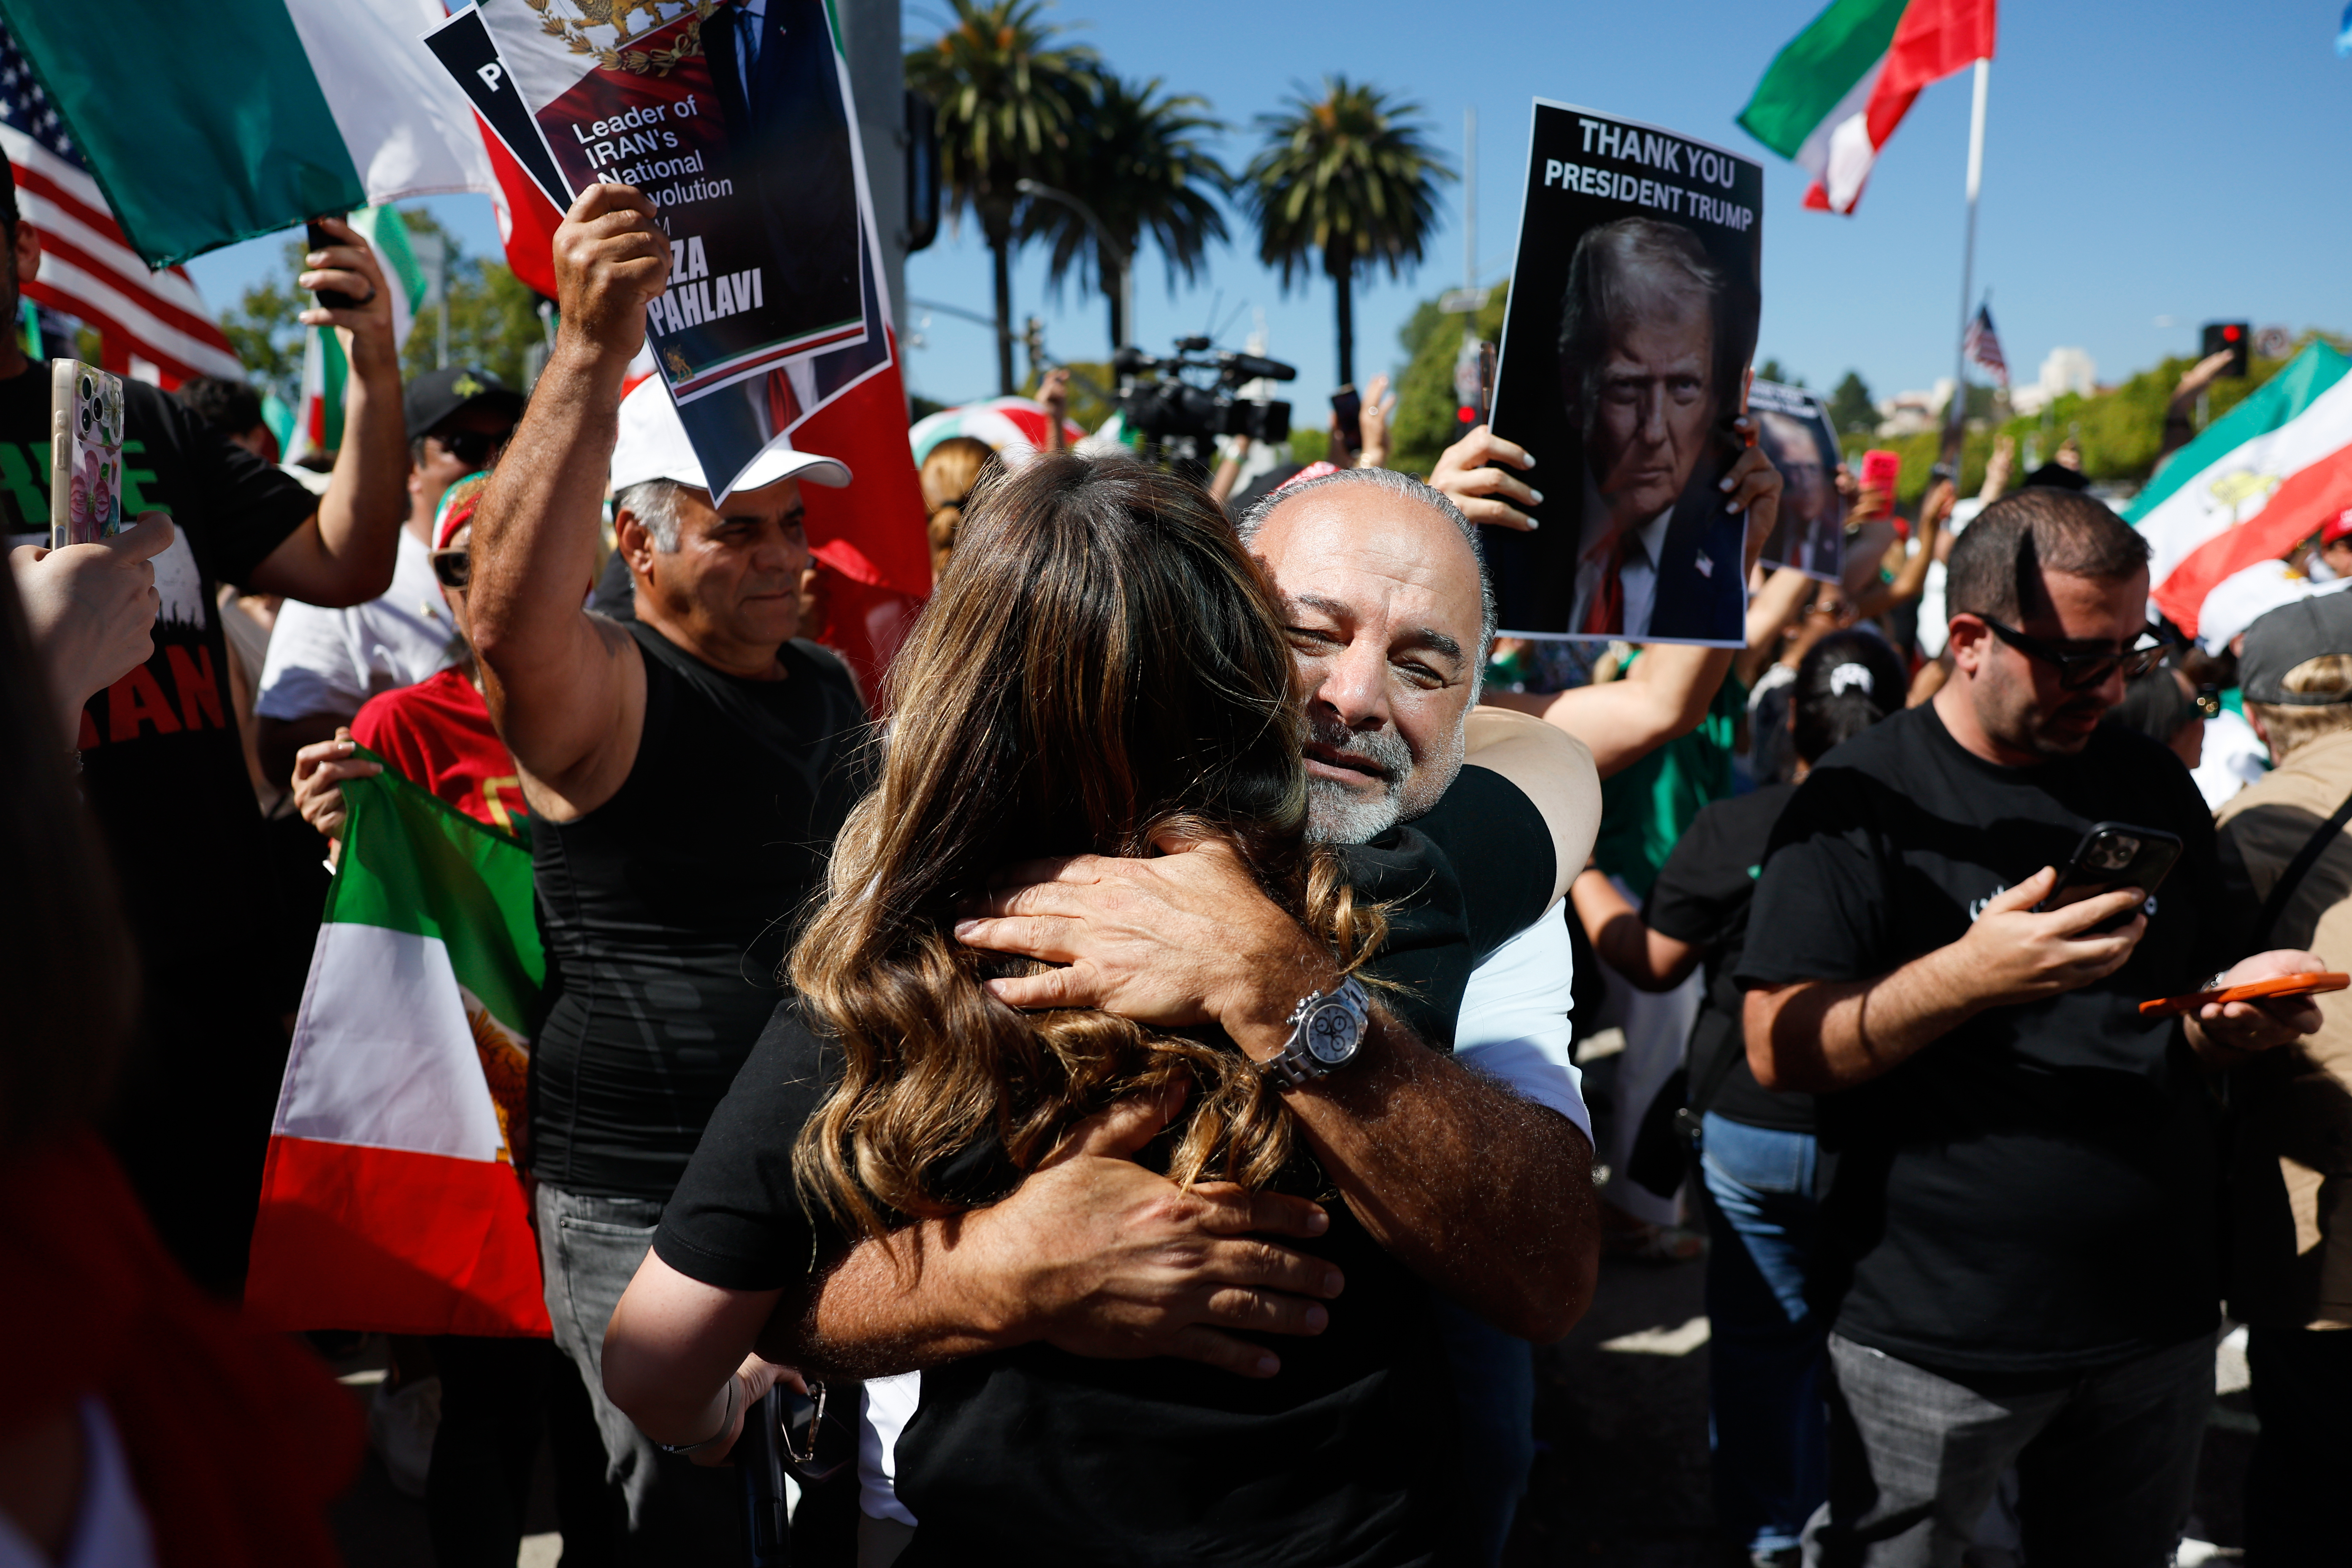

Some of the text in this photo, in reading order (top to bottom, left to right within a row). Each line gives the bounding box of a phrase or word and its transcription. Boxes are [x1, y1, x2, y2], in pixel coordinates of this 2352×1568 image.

[572, 94, 698, 144] Leader of
[585, 128, 679, 169] IRAN's
[597, 149, 704, 186] National
[1579, 117, 1735, 189] THANK YOU
[647, 177, 733, 208] volution
[1544, 158, 1754, 232] PRESIDENT TRUMP
[666, 235, 709, 287] ZA
[646, 267, 763, 337] PAHLAVI
